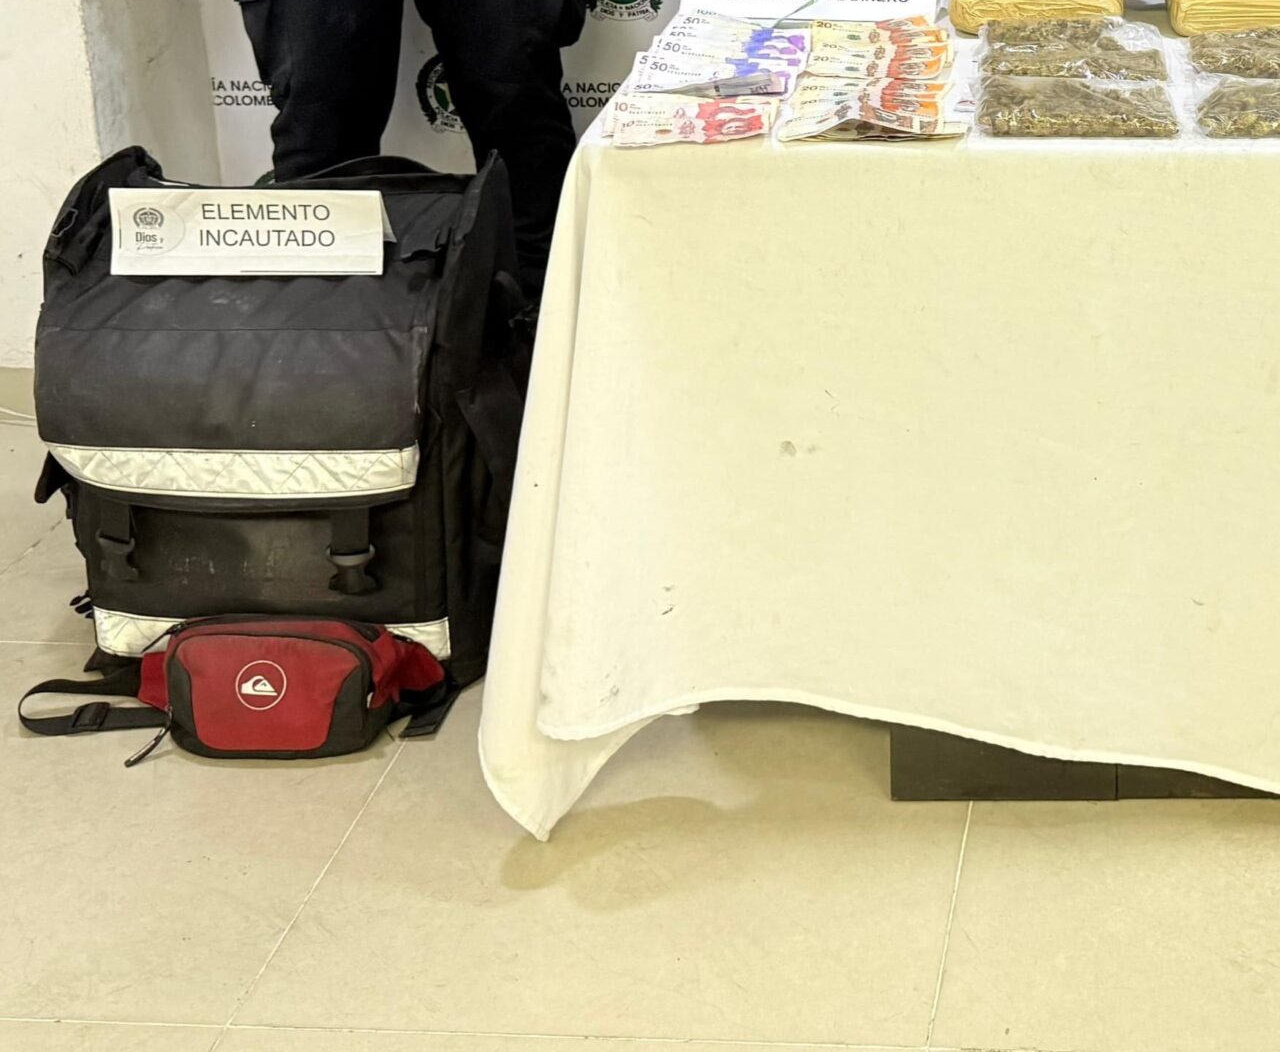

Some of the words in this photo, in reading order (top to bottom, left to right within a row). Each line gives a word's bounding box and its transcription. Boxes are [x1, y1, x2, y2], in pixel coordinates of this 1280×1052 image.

[817, 21, 832, 29] 20
[663, 42, 680, 52] 50
[650, 62, 668, 71] 50
[202, 204, 330, 220] ELEMENTO
[200, 229, 335, 247] INCAUTADO
